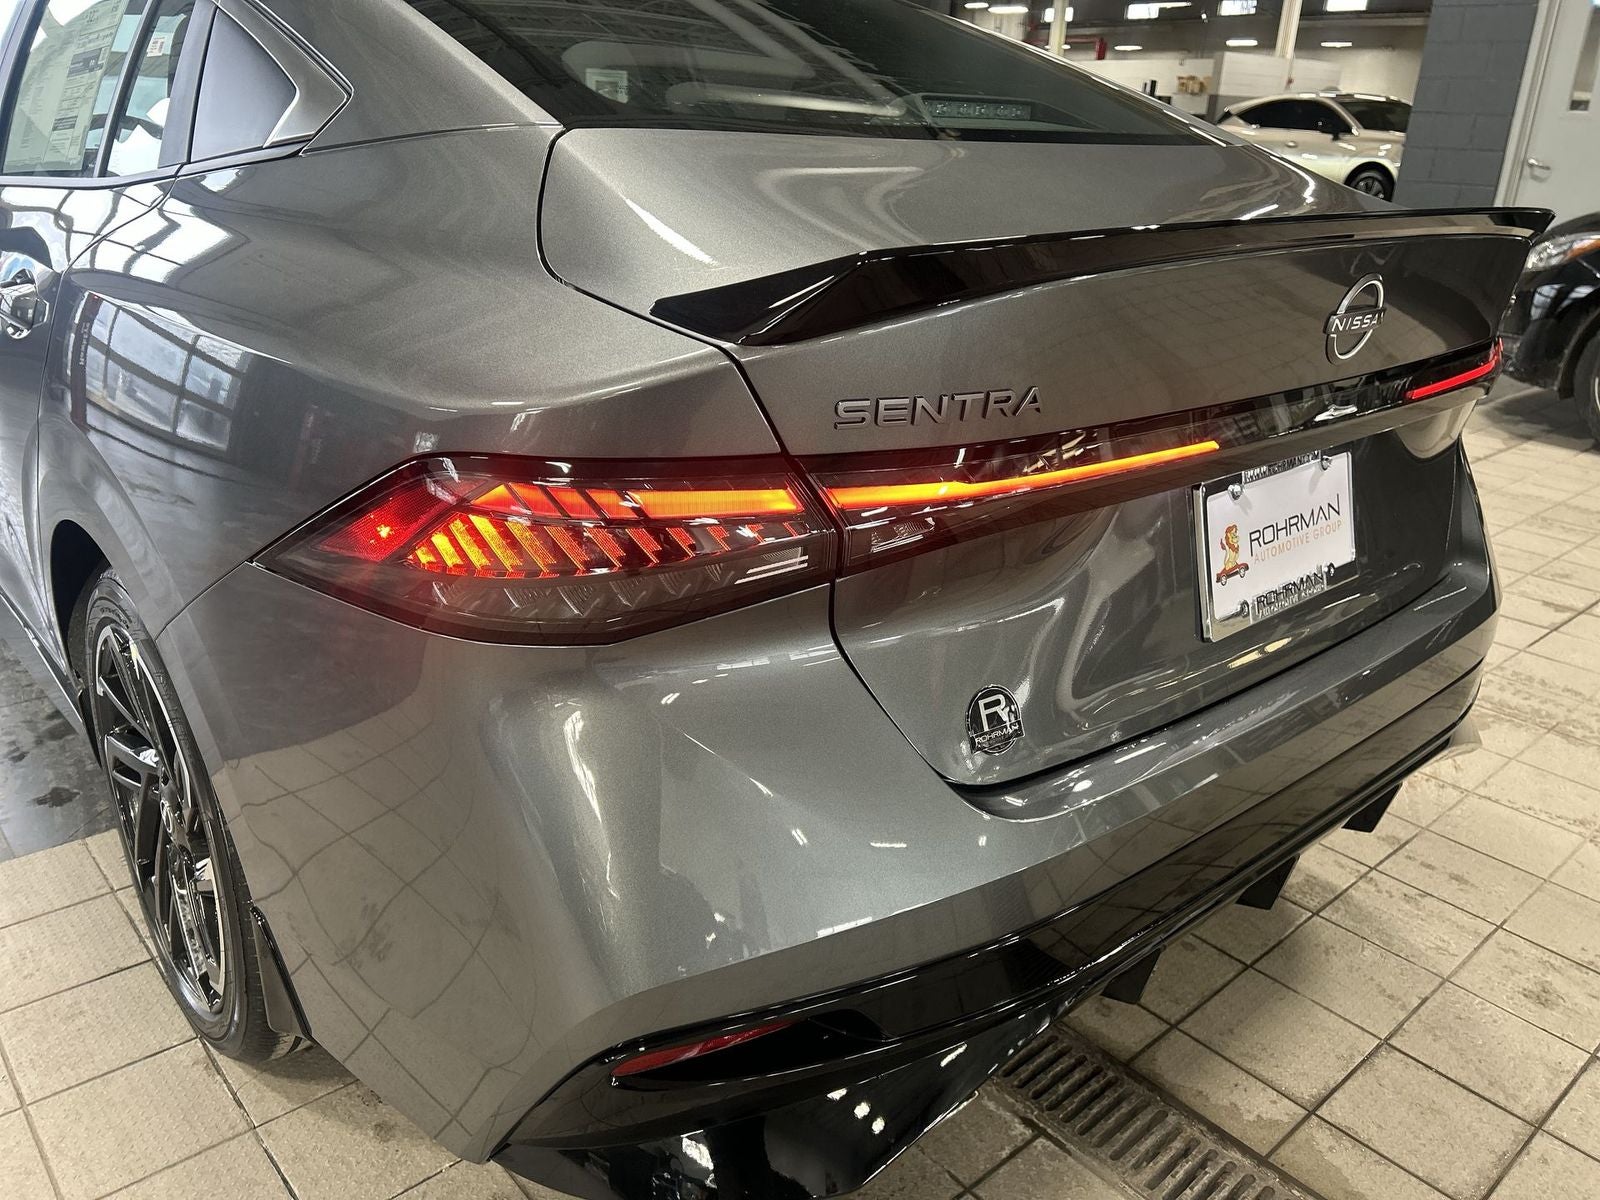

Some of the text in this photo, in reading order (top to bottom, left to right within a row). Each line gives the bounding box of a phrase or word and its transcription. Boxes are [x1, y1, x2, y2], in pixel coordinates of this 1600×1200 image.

[834, 385, 1041, 430] SENTRA
[1249, 493, 1341, 556] ROHRMAN
[1253, 520, 1343, 564] AUTOMOTIVE GROUP
[1256, 565, 1323, 614] ROHRMAN
